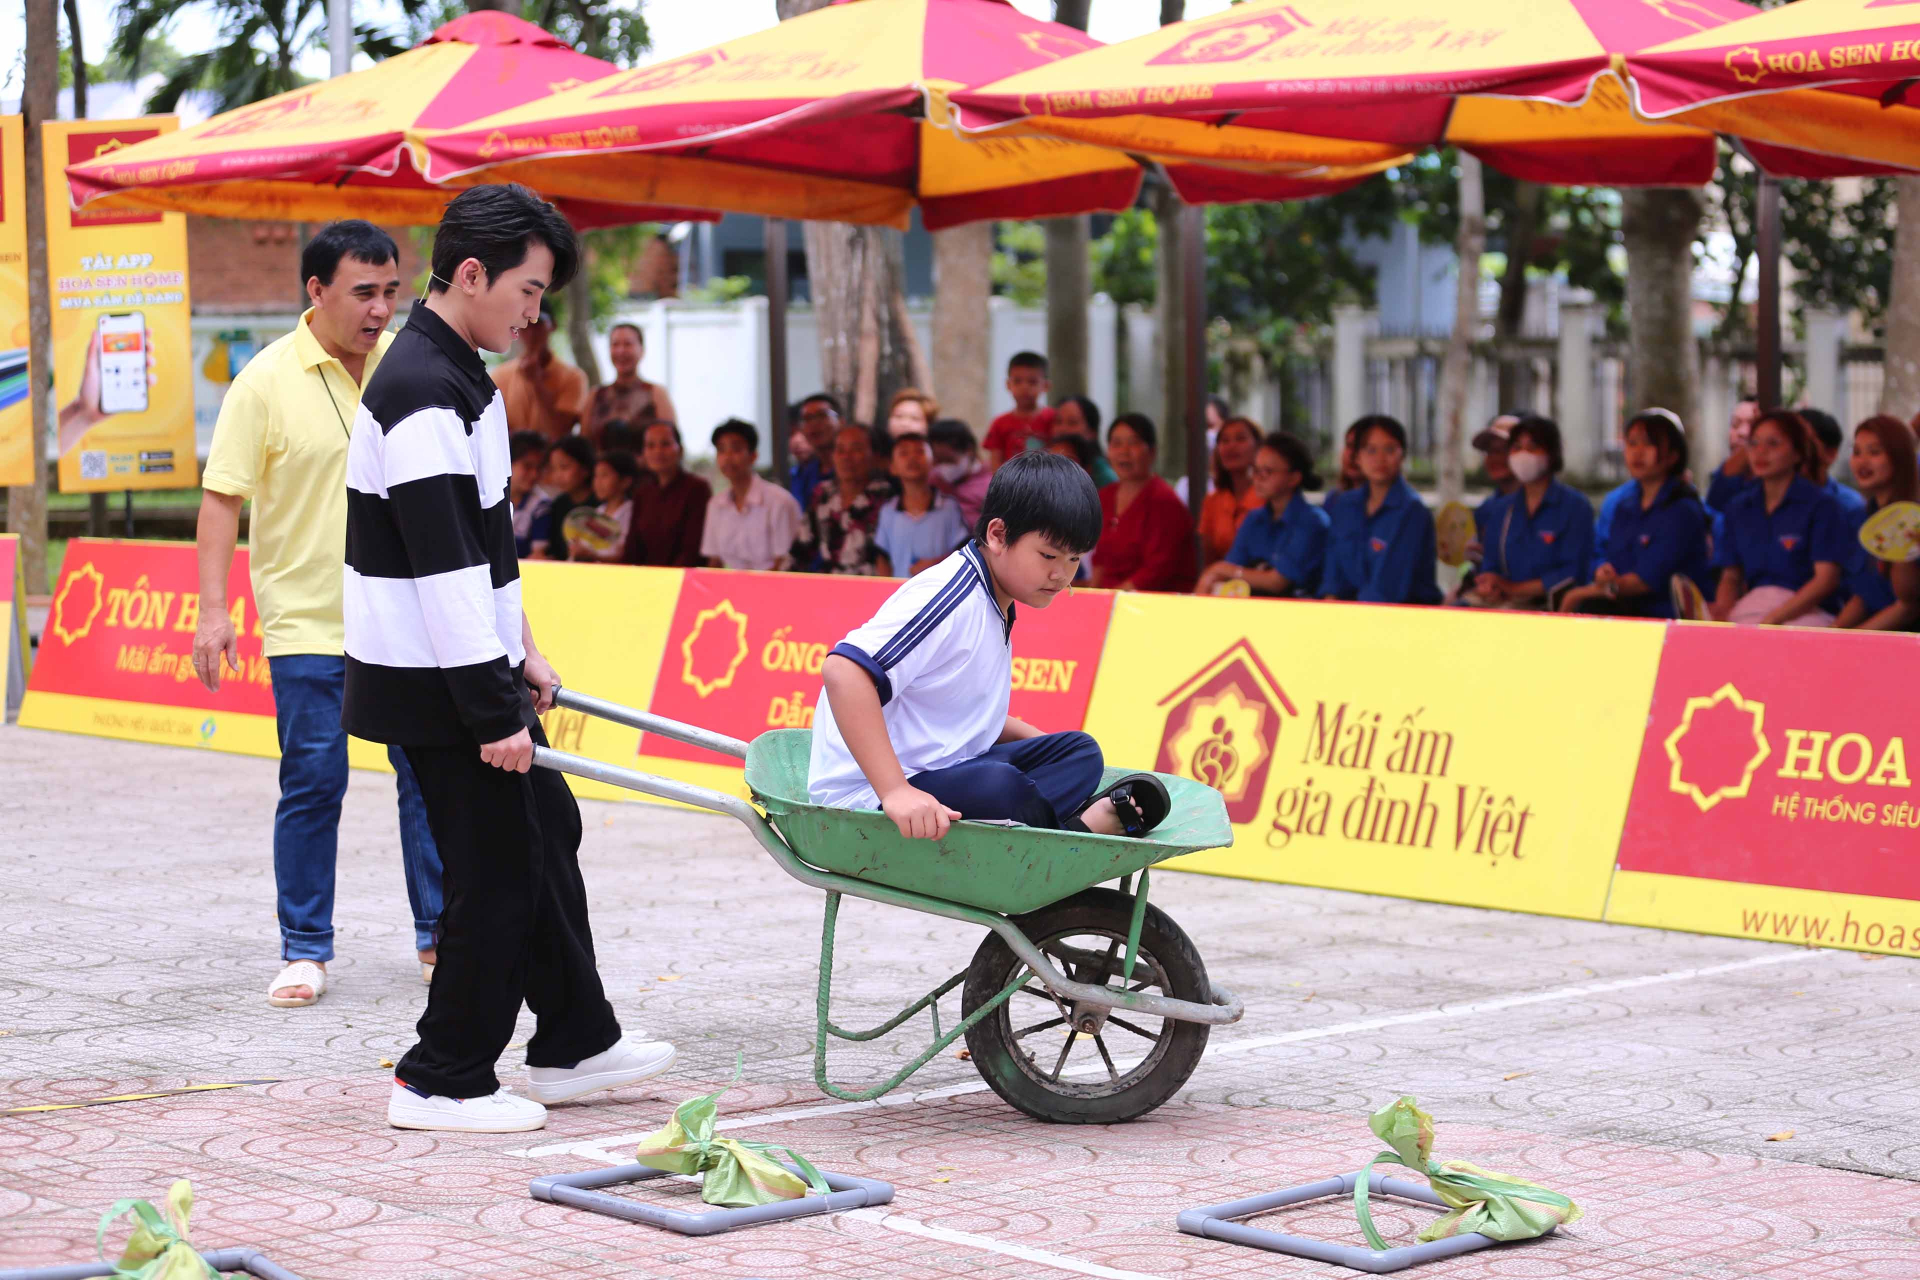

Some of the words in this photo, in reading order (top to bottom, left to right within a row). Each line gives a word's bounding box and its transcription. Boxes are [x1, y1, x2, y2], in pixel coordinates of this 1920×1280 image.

[1767, 50, 1825, 73] HOA
[1829, 42, 1886, 69] SEN
[1097, 87, 1140, 108] SEN
[549, 131, 584, 148] SEN
[117, 253, 154, 270] APP
[59, 277, 92, 291] HOA
[95, 275, 128, 289] SEN
[131, 272, 184, 288] HOME
[60, 296, 92, 309] MUA
[105, 575, 175, 630] TÔN
[173, 592, 246, 637] HA
[116, 644, 148, 673] Mái
[148, 642, 178, 676] ấm
[762, 625, 828, 675] ỐNG
[1011, 656, 1078, 693] SEN
[767, 691, 815, 729] Dẫn
[1300, 701, 1383, 770] Mái
[1386, 706, 1454, 778] ấm
[1776, 729, 1912, 787] HOA
[1266, 777, 1333, 849] gia
[1342, 775, 1440, 849] đình
[1454, 783, 1535, 868] Việt
[1771, 791, 1800, 822] HỆ
[1803, 794, 1876, 825] THỐNG
[1880, 800, 1920, 829] SIÊU
[1742, 908, 1920, 952] www.hoas
